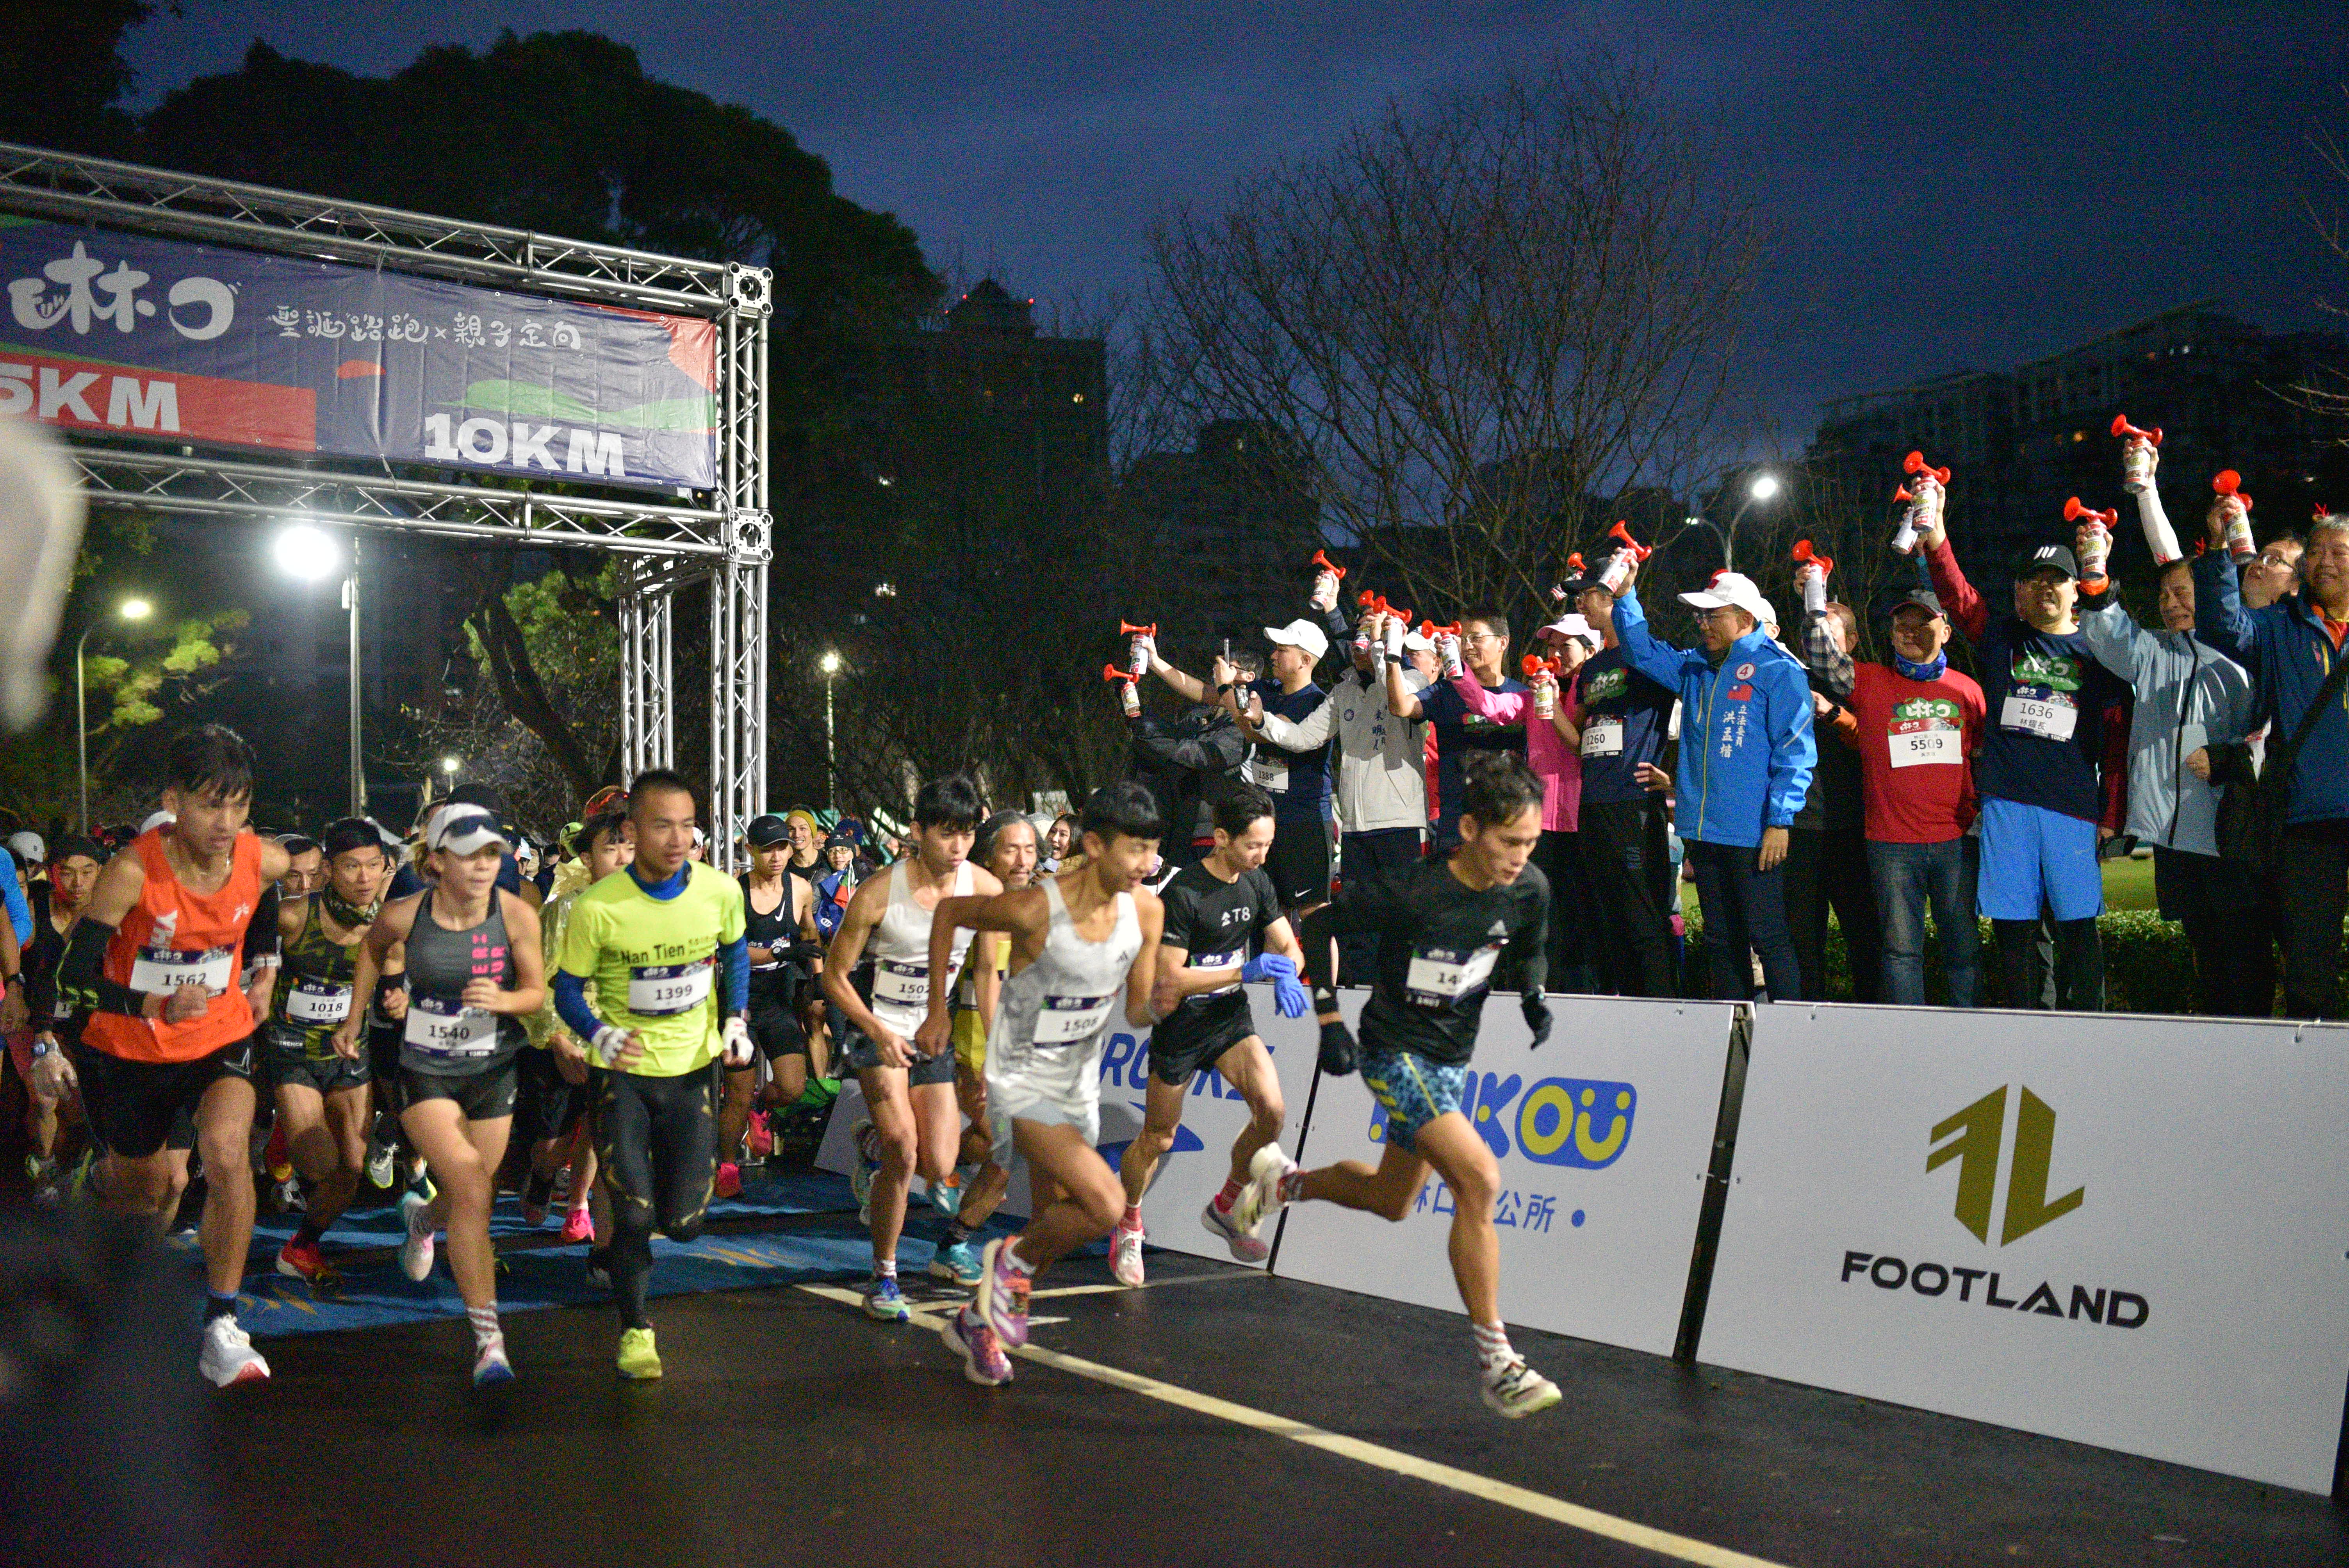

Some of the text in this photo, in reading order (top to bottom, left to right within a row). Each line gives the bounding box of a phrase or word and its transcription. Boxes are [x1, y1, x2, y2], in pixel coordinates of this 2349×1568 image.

[423, 414, 626, 476] 10KM
[1739, 666, 1749, 677] 4
[2019, 703, 2054, 719] 1636
[1586, 733, 1605, 745] 1260
[1911, 738, 1943, 751] 5509
[1259, 770, 1274, 781] 1388
[653, 943, 685, 960] Tien
[162, 972, 207, 986] 1562
[656, 984, 693, 1000] 1399
[309, 1002, 343, 1012] 1018
[428, 1025, 470, 1040] 1540
[1841, 1251, 2150, 1329] FOOTLAND
